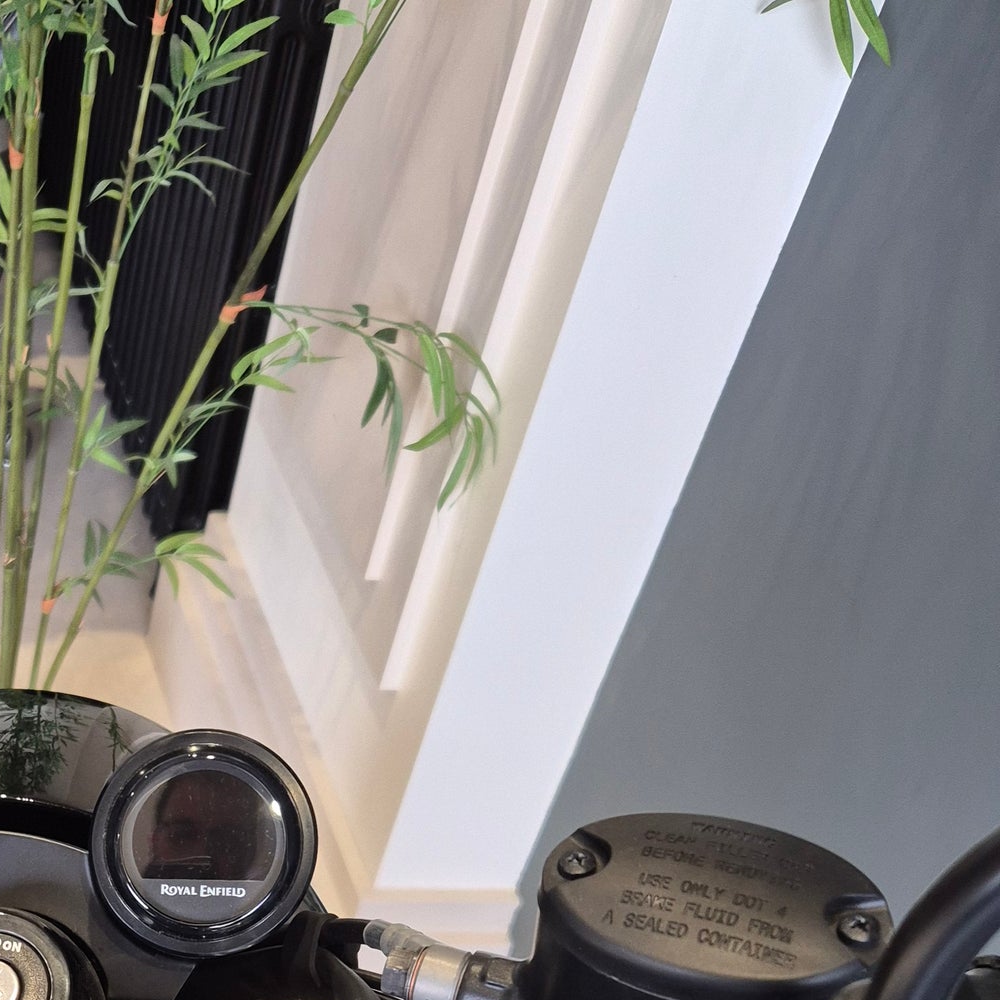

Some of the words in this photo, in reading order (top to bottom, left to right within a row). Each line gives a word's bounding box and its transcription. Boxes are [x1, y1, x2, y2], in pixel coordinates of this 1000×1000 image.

[160, 884, 198, 896] ROYAL
[200, 884, 246, 898] ENFIELD
[638, 872, 672, 890] USE
[680, 880, 726, 900] ONLY
[732, 893, 768, 911] DOT
[620, 890, 676, 912] BRAKE
[684, 901, 739, 926] FLUID
[748, 918, 794, 944] FROM
[2, 941, 22, 952] ON
[602, 910, 613, 924] A
[624, 912, 688, 938] SEALED
[697, 928, 798, 970] CONTAINER
